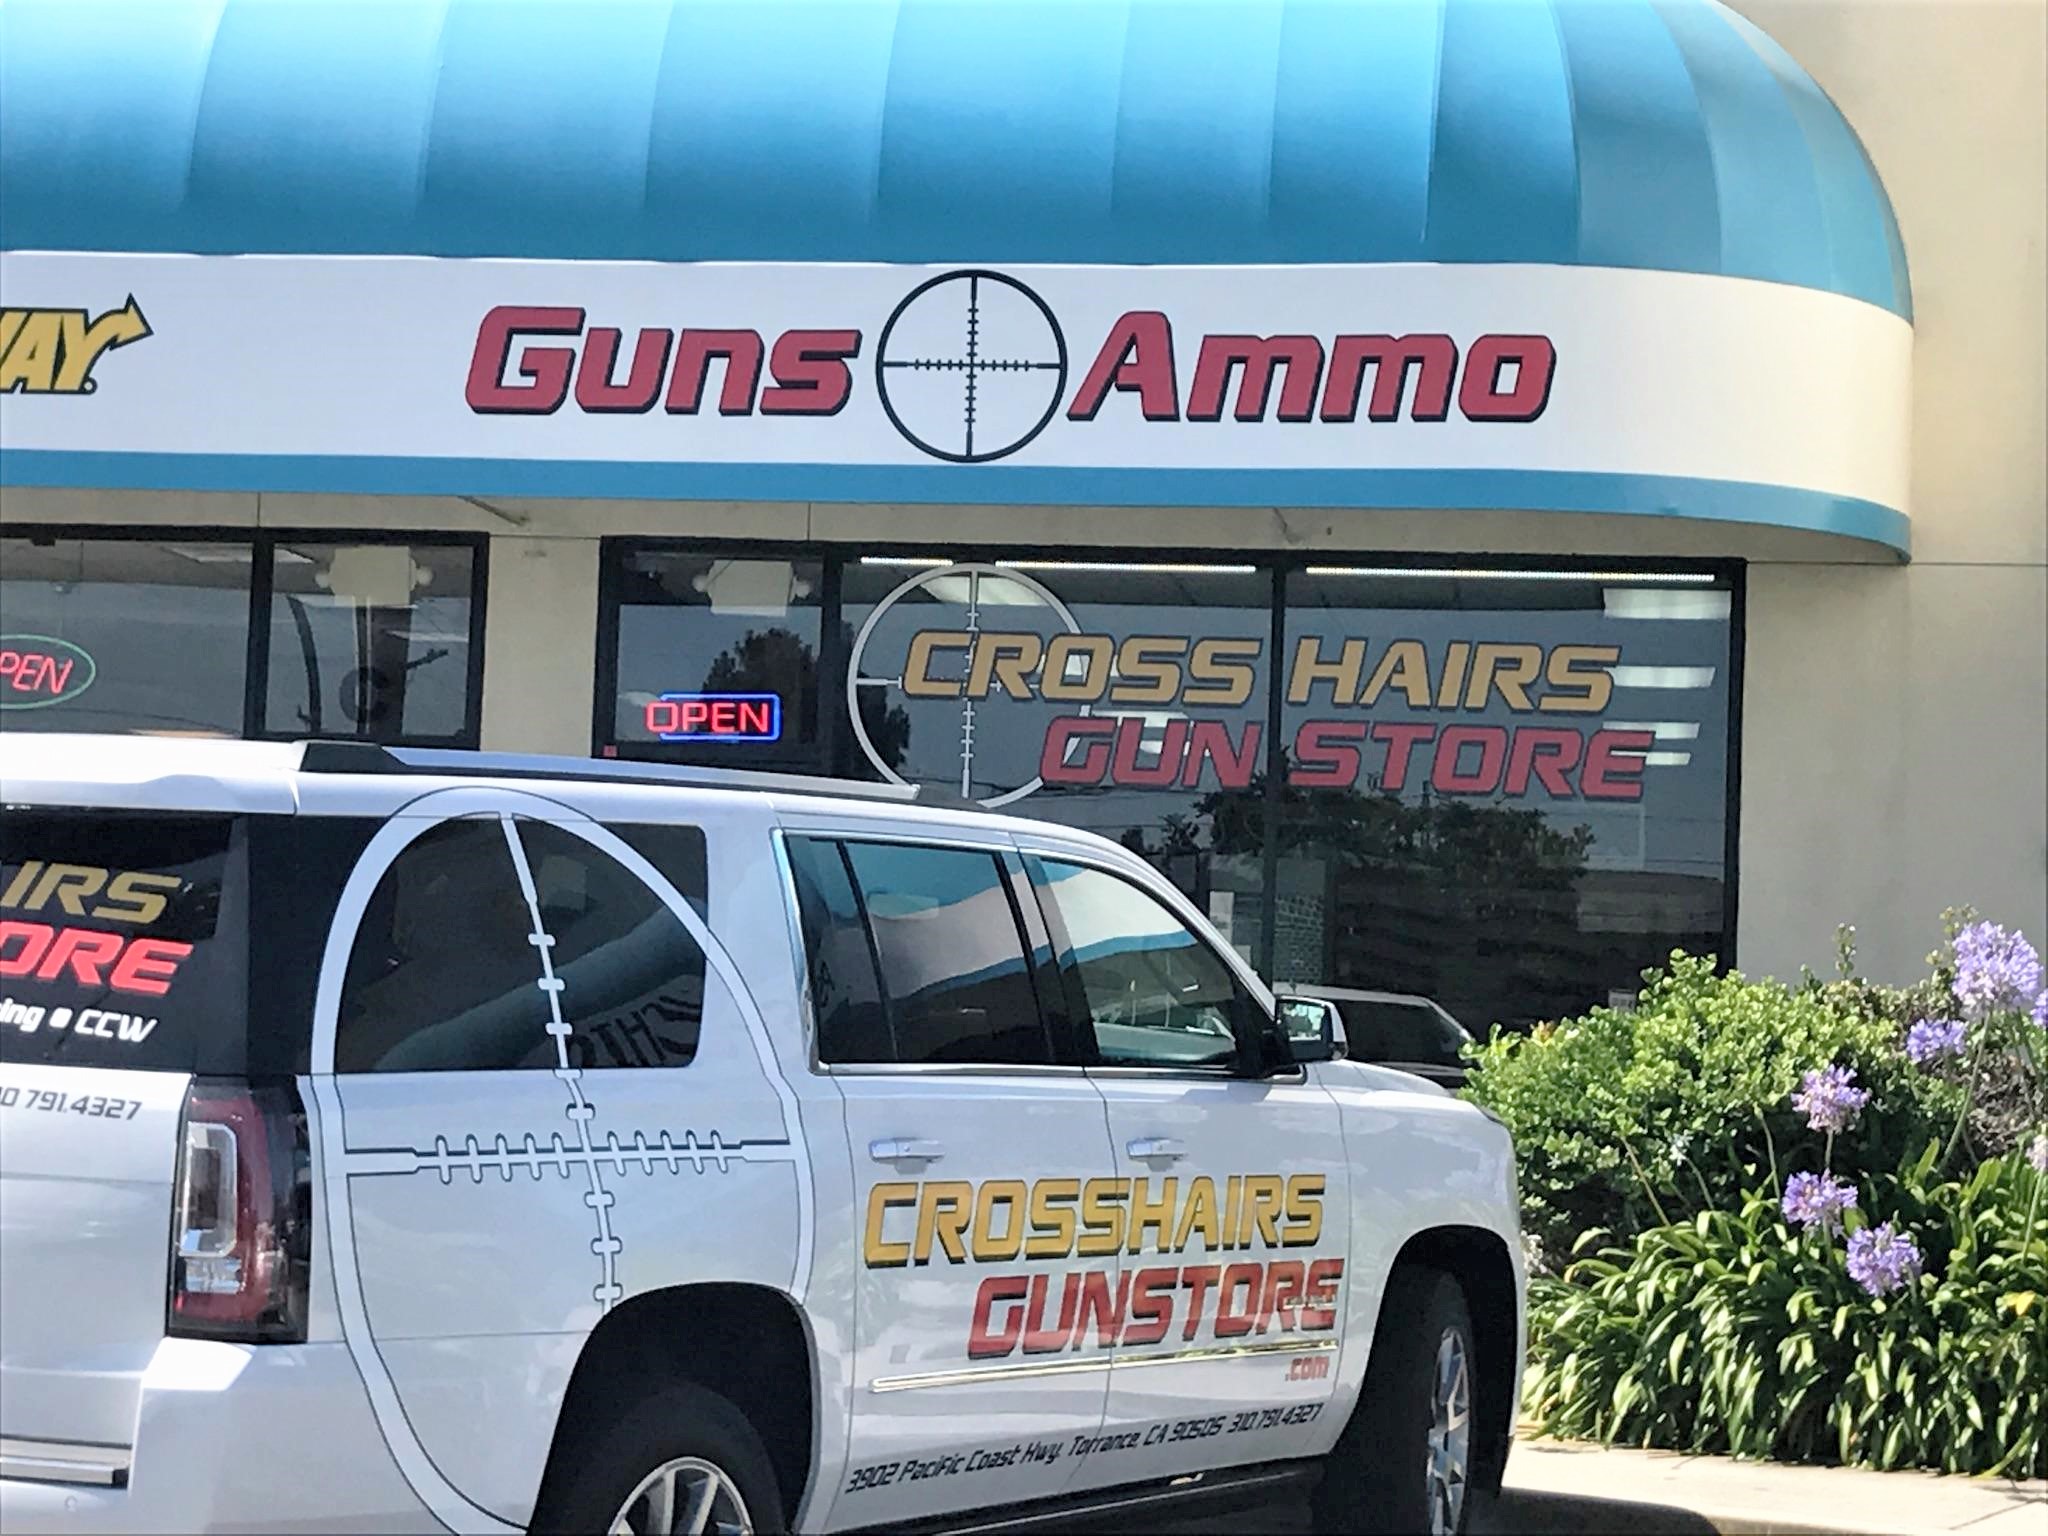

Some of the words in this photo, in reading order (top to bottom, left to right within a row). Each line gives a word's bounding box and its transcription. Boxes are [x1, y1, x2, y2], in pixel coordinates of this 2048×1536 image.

[903, 630, 1263, 707] CROSS
[1286, 635, 1622, 715] HAIRS
[645, 702, 769, 734] OPEN
[1039, 715, 1263, 791] GUN
[1288, 718, 1656, 801] STORE
[0, 997, 46, 1033] ing
[74, 1008, 158, 1043] CCW
[25, 1089, 142, 1121] 791.4327
[865, 1173, 1327, 1269] CROSSHAIRS
[967, 1258, 1345, 1360] GUNSTORE
[1285, 1356, 1329, 1382] .com
[845, 1462, 902, 1495] 3902
[898, 1452, 966, 1483] Pacific
[965, 1445, 1021, 1474] Coast
[1143, 1423, 1171, 1447] CA
[1168, 1415, 1226, 1443] 90505
